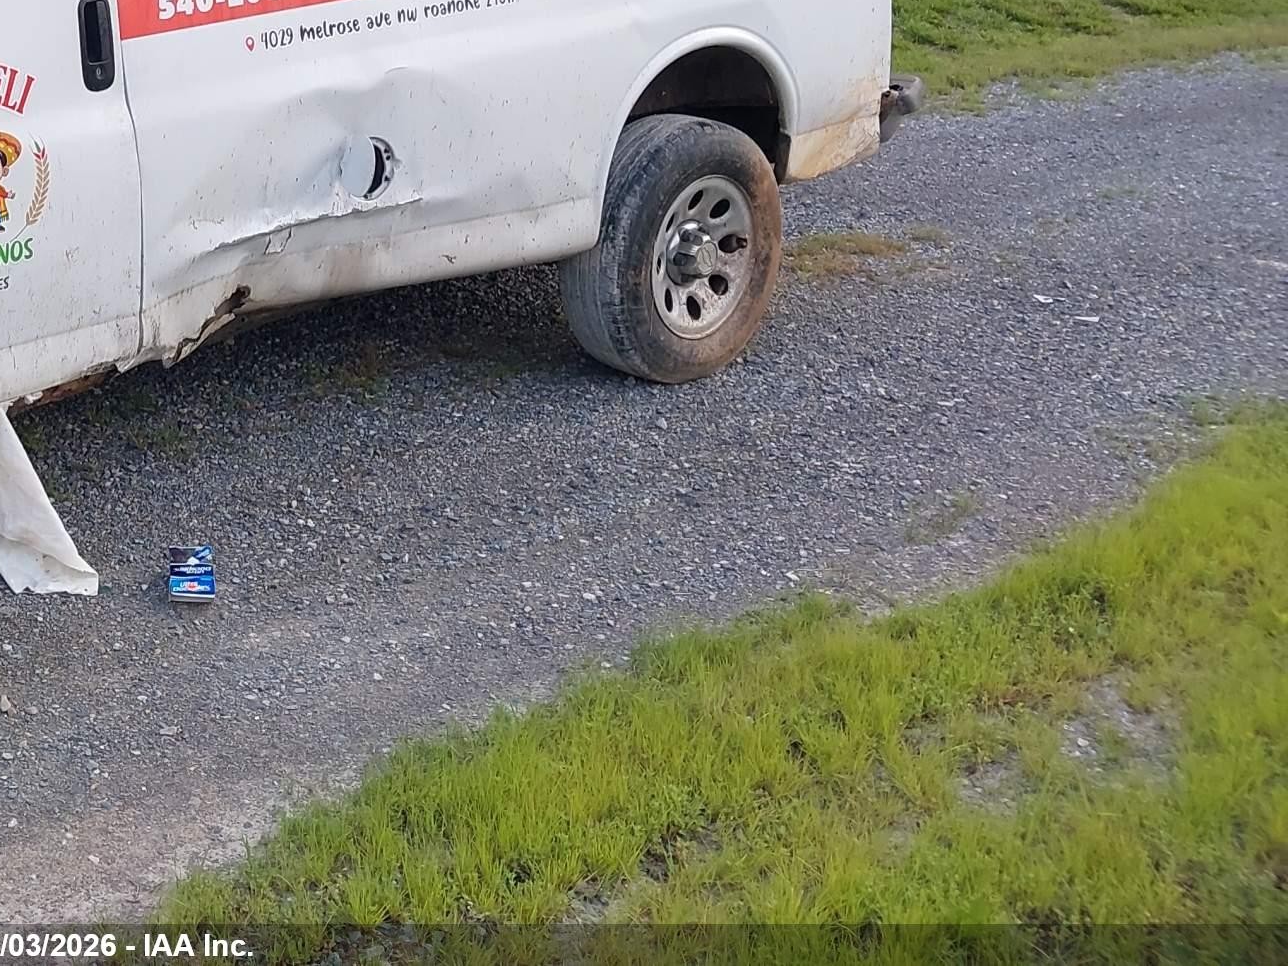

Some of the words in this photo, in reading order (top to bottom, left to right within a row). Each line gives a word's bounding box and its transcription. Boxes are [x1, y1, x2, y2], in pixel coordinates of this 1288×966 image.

[261, 28, 293, 50] 4029
[299, 16, 360, 42] melrose
[366, 10, 391, 30] ave
[397, 7, 417, 22] nw
